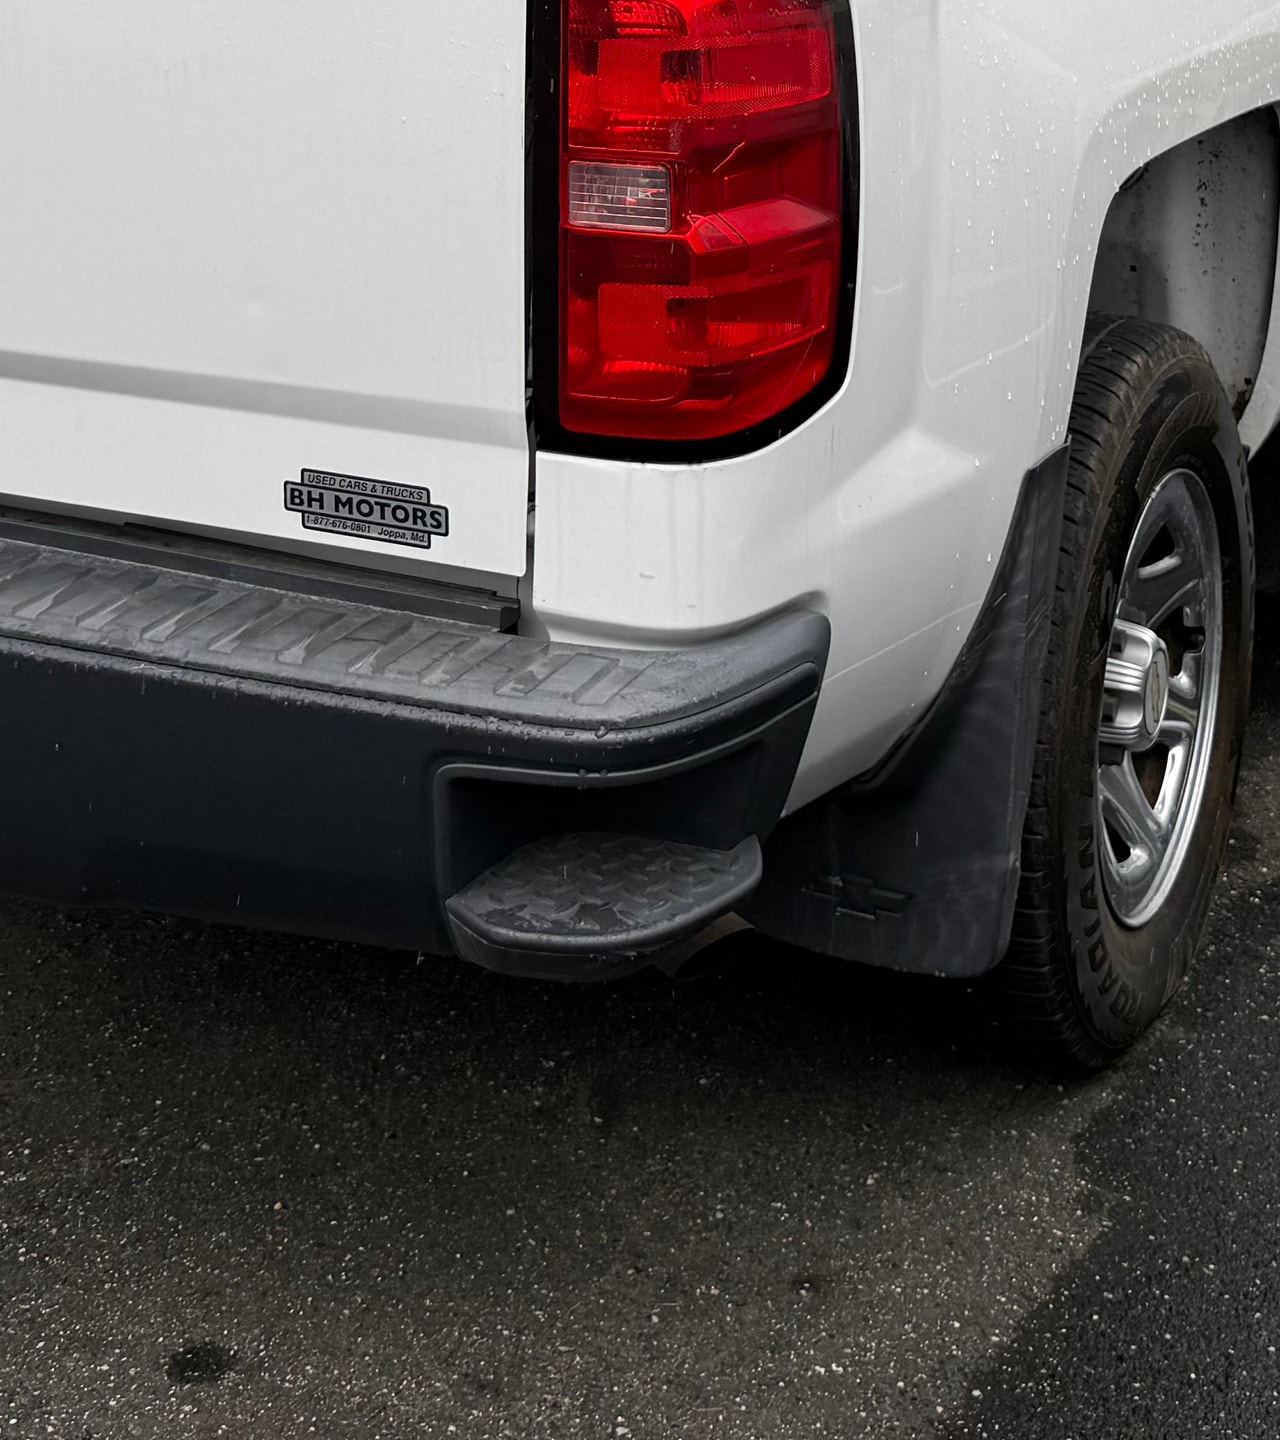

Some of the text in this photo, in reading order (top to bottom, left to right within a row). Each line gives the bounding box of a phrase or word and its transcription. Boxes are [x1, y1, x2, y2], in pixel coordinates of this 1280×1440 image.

[308, 473, 424, 501] USED CARS & TRUCKS
[289, 487, 443, 530] BH MOTORS
[377, 527, 409, 542] Joppa,
